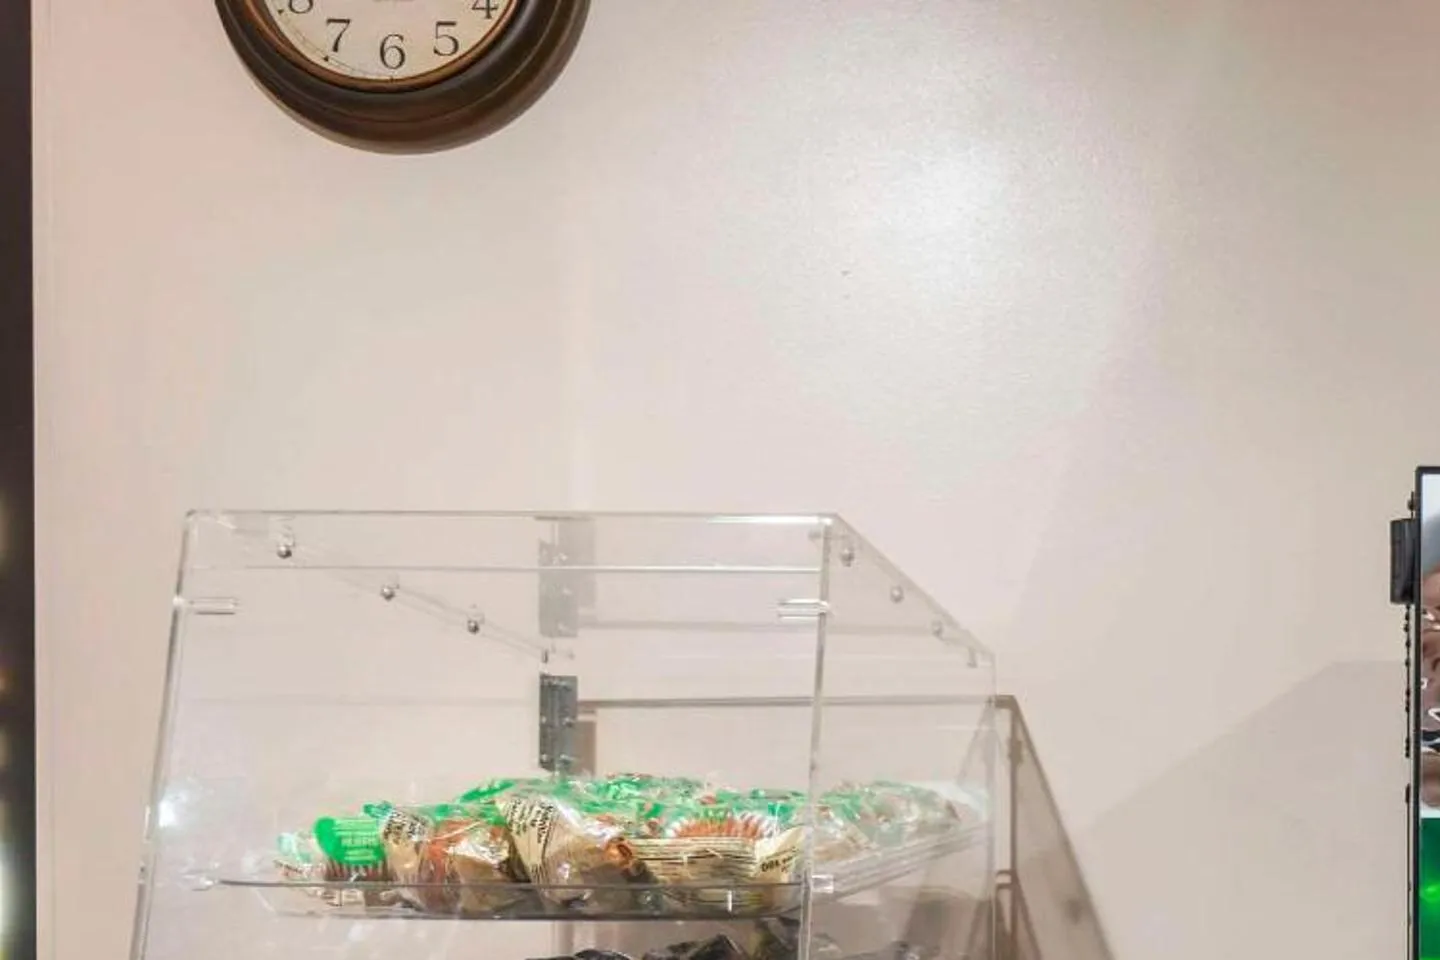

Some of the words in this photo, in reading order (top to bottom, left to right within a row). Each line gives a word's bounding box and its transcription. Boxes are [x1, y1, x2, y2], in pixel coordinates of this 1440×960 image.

[325, 18, 351, 52] 7
[379, 34, 406, 70] 6
[433, 21, 460, 56] 5
